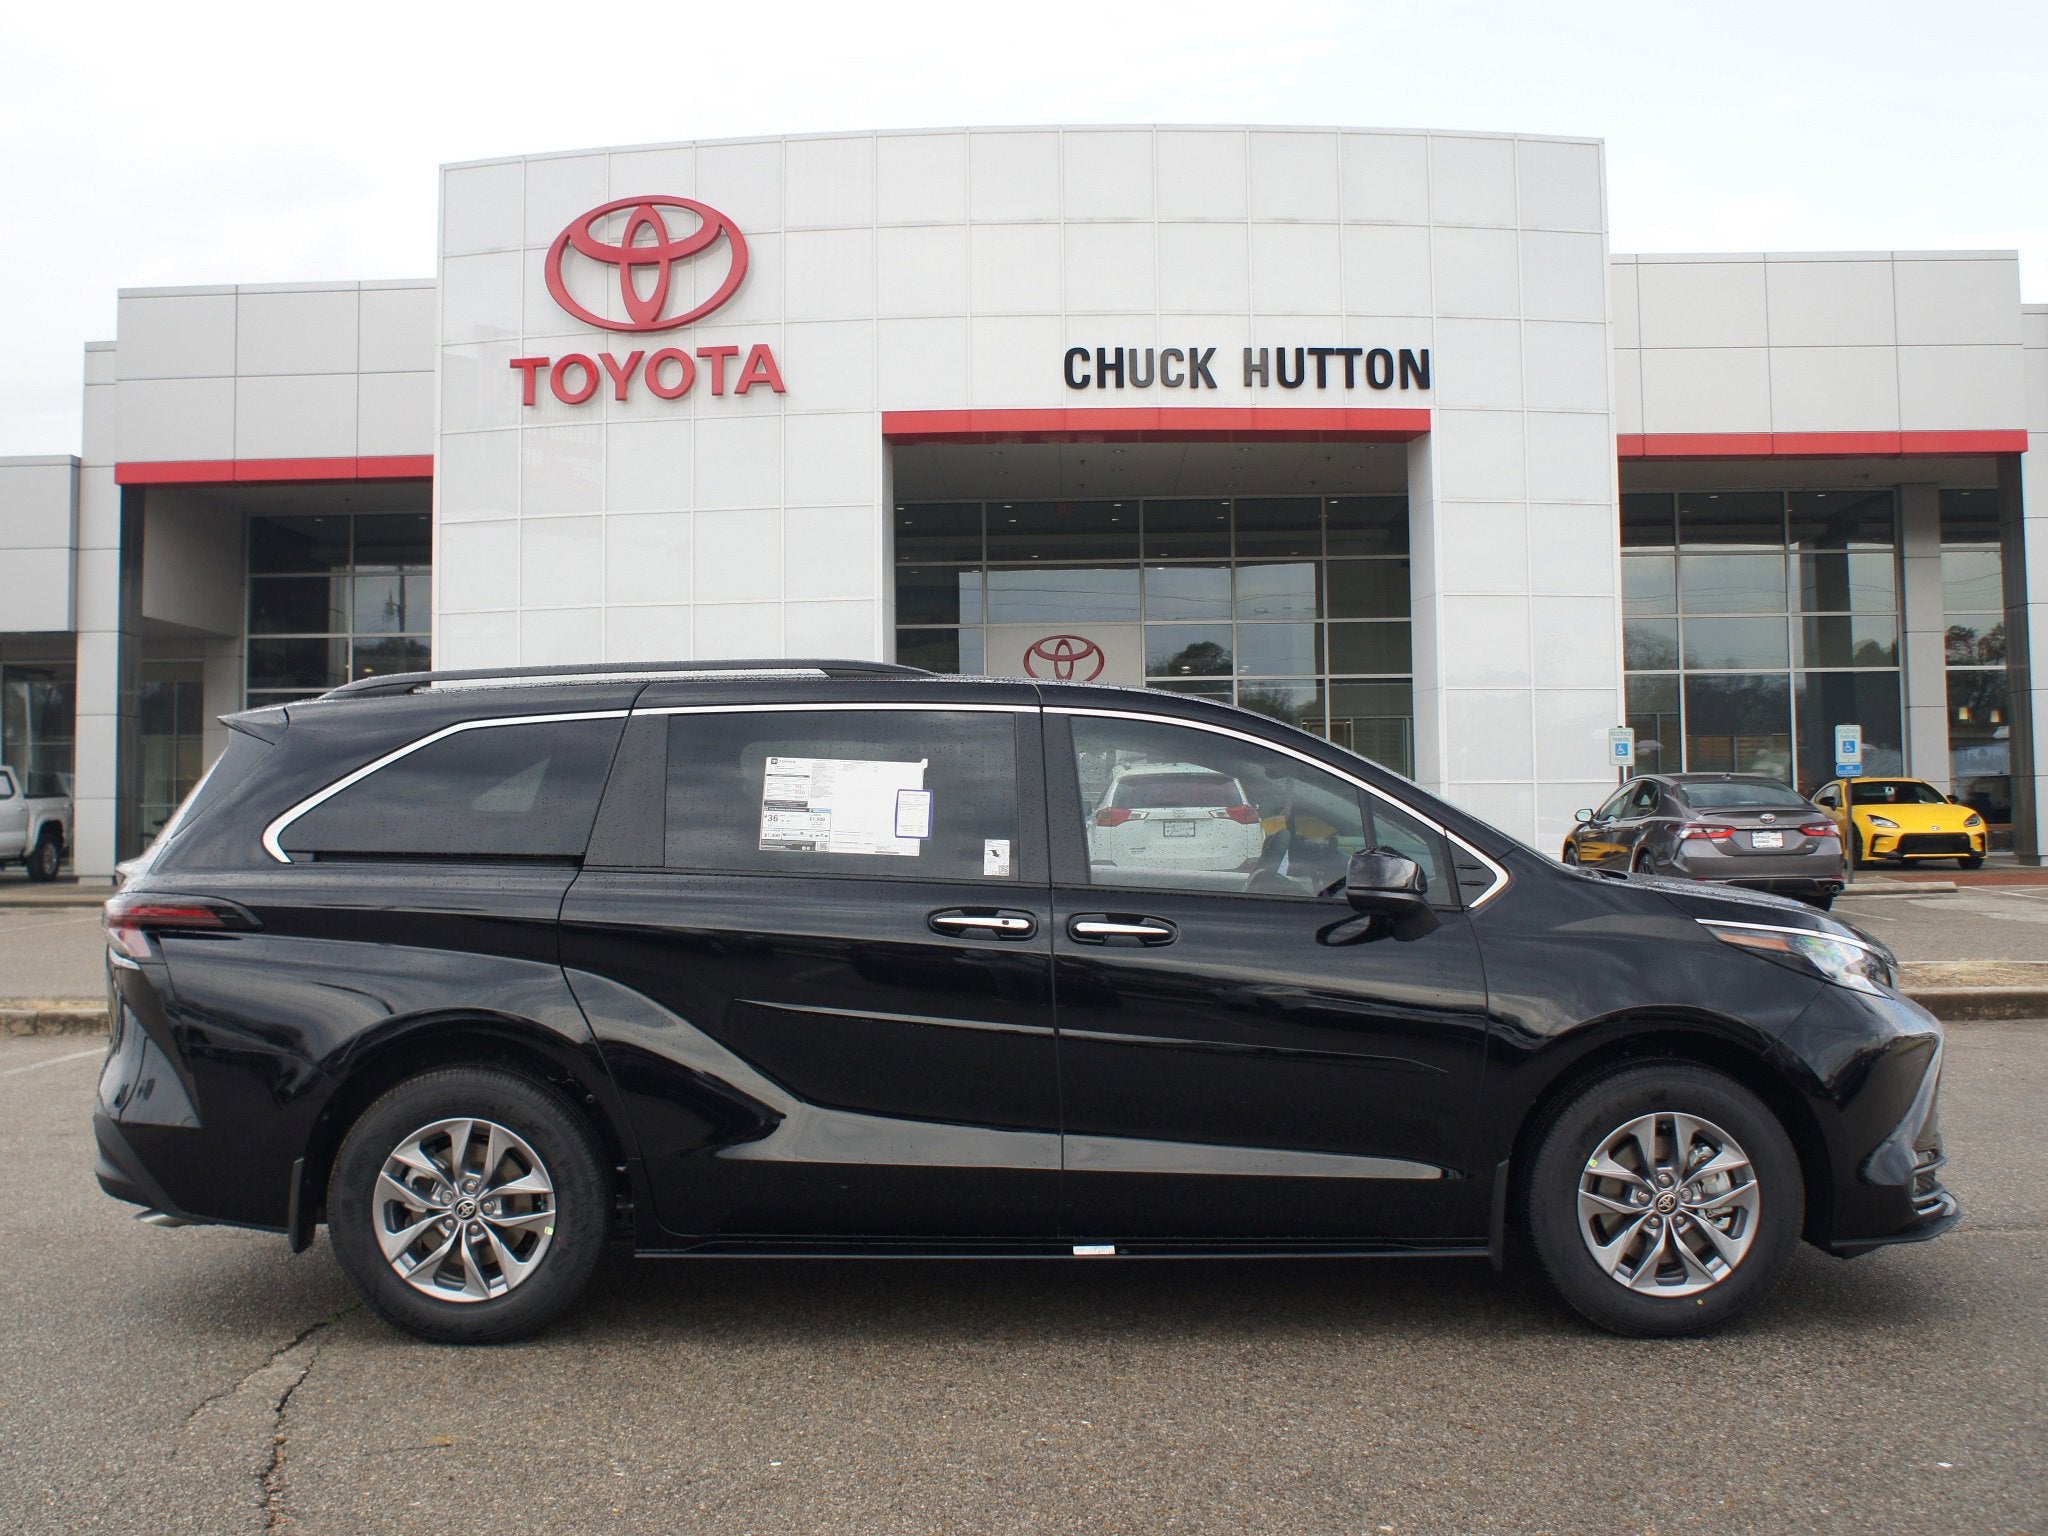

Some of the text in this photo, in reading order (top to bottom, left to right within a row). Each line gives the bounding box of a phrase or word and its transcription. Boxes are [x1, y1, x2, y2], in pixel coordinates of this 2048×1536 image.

[509, 343, 787, 407] TOYOTA
[1063, 347, 1431, 390] CHUCK HUTTON
[767, 814, 779, 822] 36
